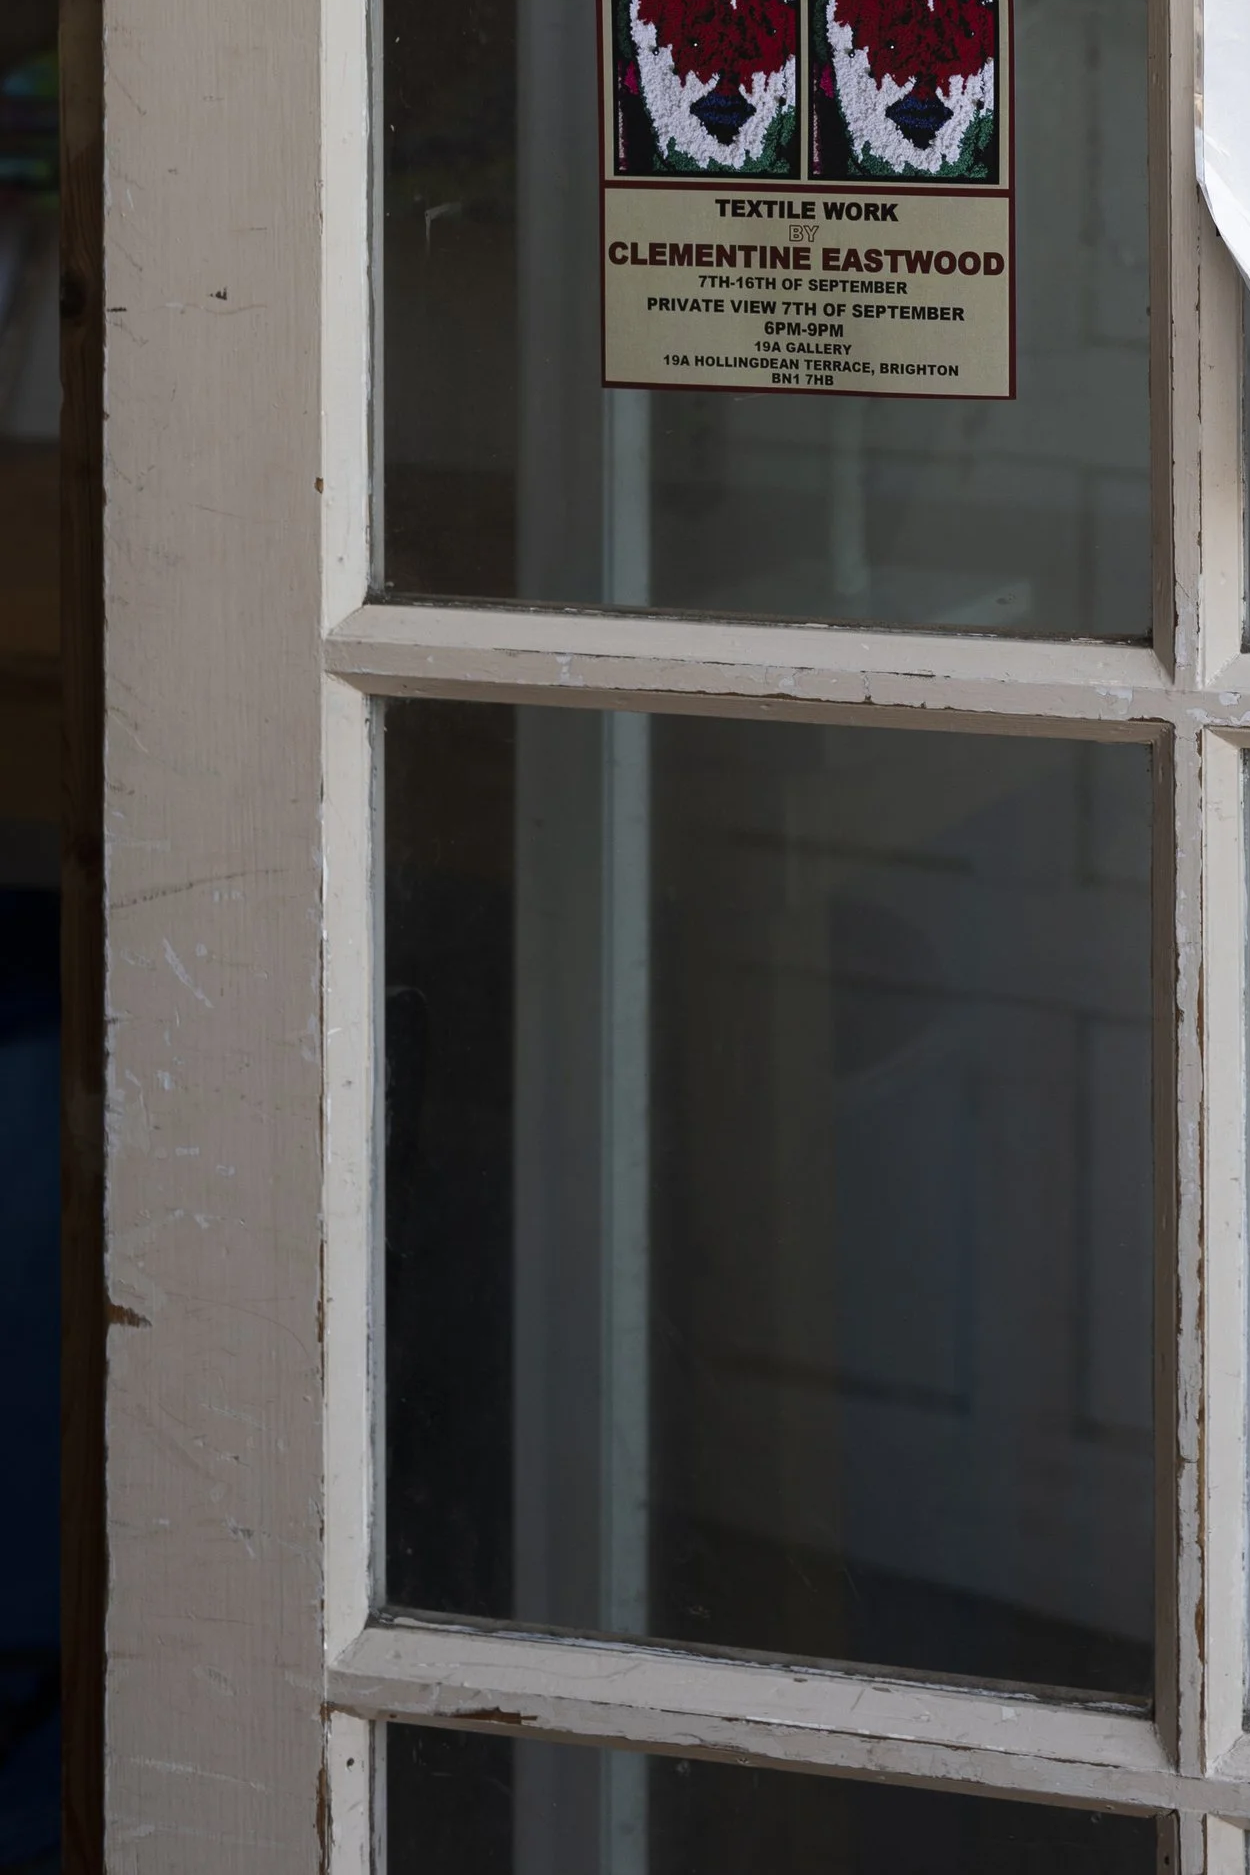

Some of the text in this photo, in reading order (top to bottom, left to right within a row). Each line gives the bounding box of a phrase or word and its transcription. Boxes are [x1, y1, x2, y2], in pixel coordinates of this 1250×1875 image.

[715, 199, 898, 221] TEXTILE WORK
[789, 225, 819, 242] BY
[609, 242, 1004, 275] CLEMENTINE EASTWOOD
[699, 275, 907, 294] 7TH-16TH OF SEPTEMBER
[648, 297, 964, 321] PRIVATE VIEW 7TH OF SEPTEMBER
[765, 321, 843, 337] 6PM-9PM
[755, 341, 851, 355] 19A GALLERY
[664, 355, 958, 376] 19A HOLLINGDEAN TERRACE, BRIGHTON
[772, 373, 833, 385] BN1 7HB
